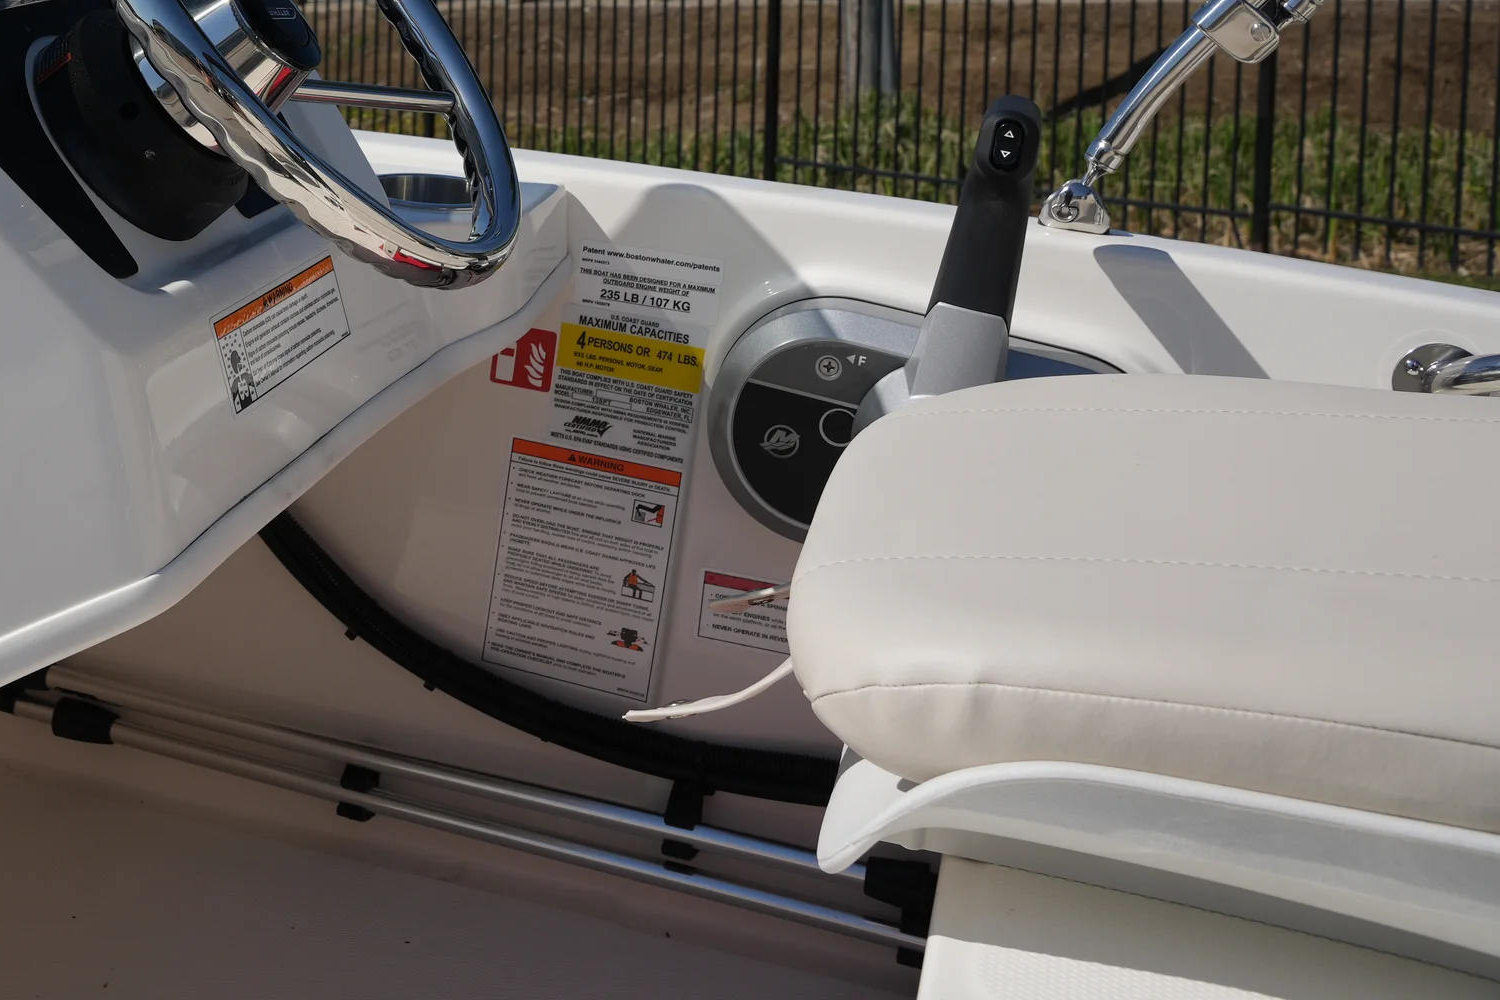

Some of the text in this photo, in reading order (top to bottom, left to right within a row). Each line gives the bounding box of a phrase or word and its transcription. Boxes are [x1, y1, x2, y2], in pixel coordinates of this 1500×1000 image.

[582, 246, 605, 254] Patent
[607, 251, 719, 271] www.bostonwhaler.com/patents
[267, 282, 294, 304] WARNING
[603, 278, 634, 288] OUTBOARD
[635, 283, 656, 291] ENGINE
[658, 287, 680, 295] WEIGHT
[639, 276, 668, 285] DESIGNED
[687, 284, 715, 293] MAXIMUM
[600, 288, 620, 300] 235
[623, 292, 639, 303] LB
[651, 296, 669, 307] 107
[672, 300, 690, 311] KG
[579, 315, 689, 343] MAXIMUM CAPACITIES
[621, 316, 639, 324] COAST
[640, 319, 659, 327] GUARD
[587, 337, 632, 353] PERSONS
[635, 346, 650, 357] OR
[656, 350, 672, 361] 474
[677, 353, 698, 366] LBS.
[858, 355, 867, 366] F
[558, 375, 587, 385] STANDARDS
[633, 389, 646, 397] DATE
[655, 394, 692, 405] CERTIFICATION
[586, 373, 611, 383] COMPLIES
[636, 383, 653, 391] COAST
[654, 387, 672, 395] GUARD
[673, 390, 693, 399] SAFETY
[629, 397, 652, 406] BOSTON
[654, 402, 678, 411] WHALER,
[646, 407, 681, 419] EDGEWATER,
[578, 455, 624, 471] WARNING
[743, 612, 770, 621] ENGINES
